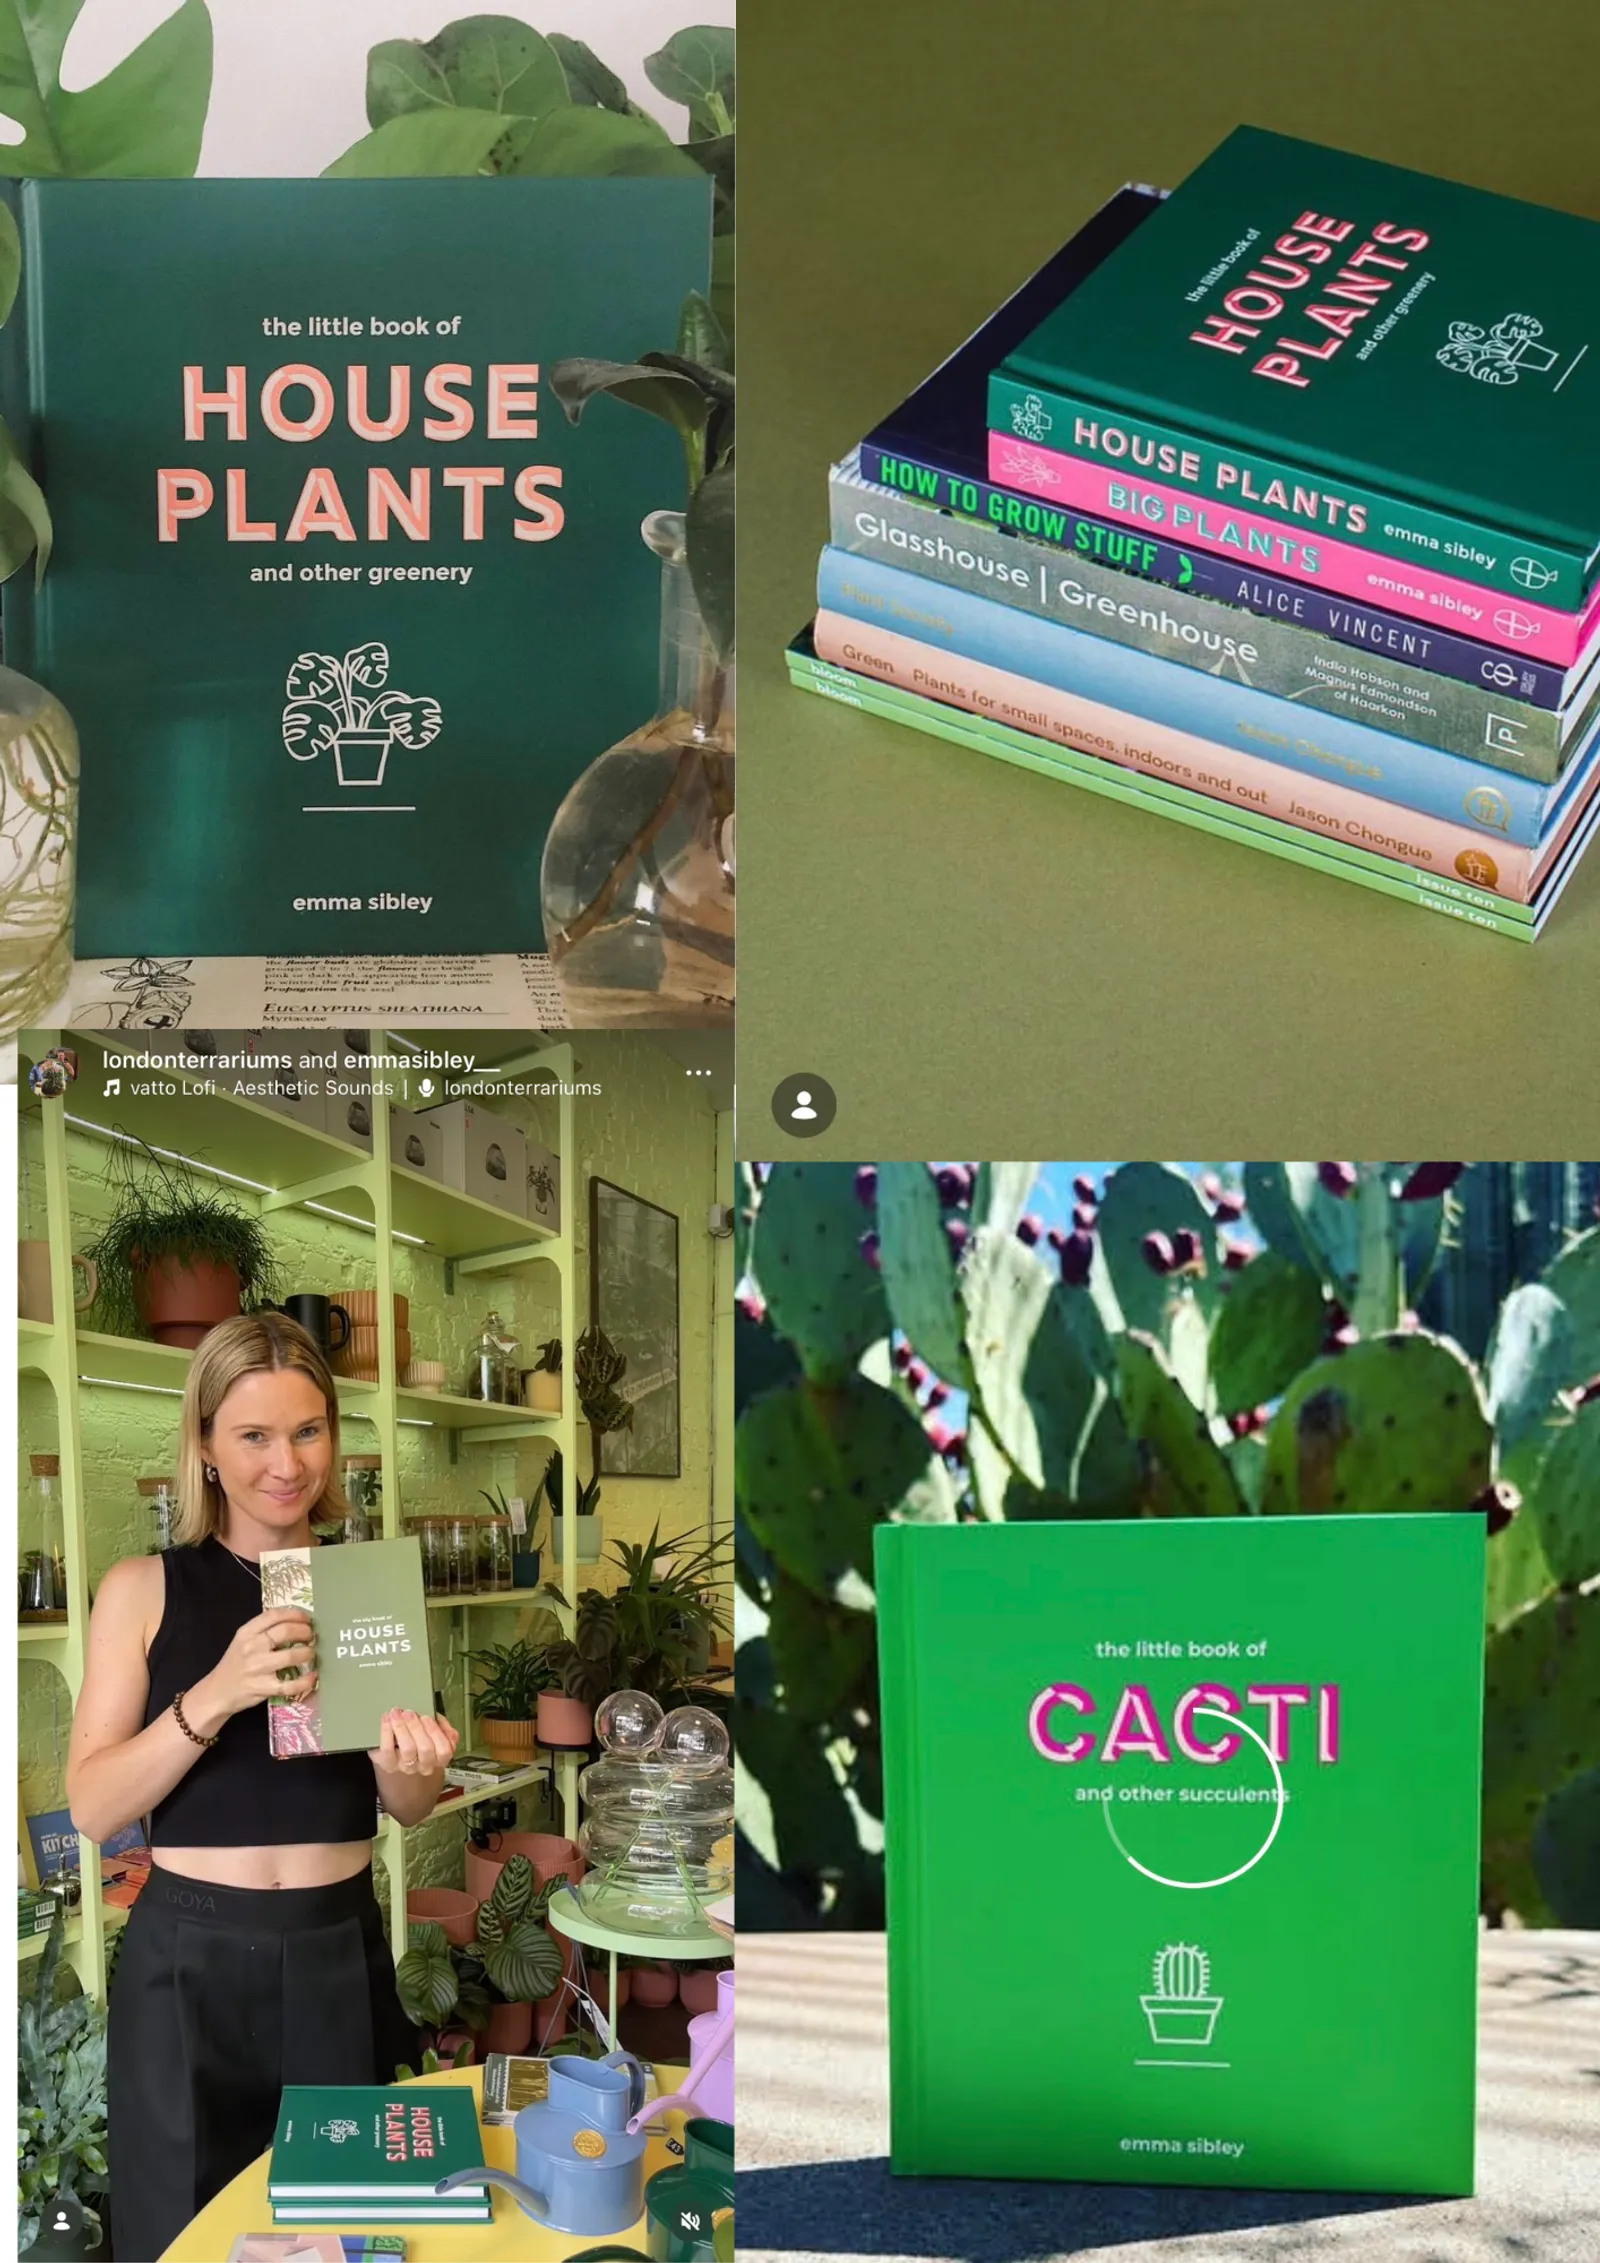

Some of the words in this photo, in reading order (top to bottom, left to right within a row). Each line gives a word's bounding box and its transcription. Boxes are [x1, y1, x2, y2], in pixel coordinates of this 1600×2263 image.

[1184, 286, 1208, 302] the
[1200, 263, 1229, 286] little
[1221, 240, 1253, 263] book
[1246, 227, 1261, 240] of
[1189, 210, 1355, 355] HOUSE
[262, 317, 301, 336] the
[308, 317, 363, 336] little
[370, 317, 429, 336] book
[436, 316, 461, 336] of
[1251, 221, 1430, 388] PLANTS
[1356, 339, 1378, 361] and
[1373, 313, 1399, 340] other
[1394, 271, 1436, 315] greenery
[183, 363, 540, 442] HOUSE
[157, 465, 565, 542] PLANTS
[1074, 417, 1200, 481] HOUSE
[1216, 462, 1368, 533] PLANTS
[1384, 523, 1439, 551] emma
[1444, 540, 1496, 569] sibley
[250, 564, 292, 582] and
[299, 564, 362, 582] other
[368, 566, 473, 585] greenery
[880, 457, 938, 499] HOW
[947, 477, 978, 512] TO
[987, 493, 1067, 540] GROW
[1075, 521, 1158, 572] STUFF
[1237, 581, 1304, 618] ALICE
[1329, 608, 1432, 658] VINCENT
[1108, 481, 1165, 522] BIG
[1173, 504, 1321, 573] PLANTS
[1367, 572, 1425, 601] emma
[1430, 590, 1483, 621] sibley
[855, 512, 1030, 589] Glasshouse
[1059, 580, 1259, 663] Greenhouse
[1304, 667, 1356, 690] Magnus
[1360, 683, 1437, 717] Edmondson
[1314, 655, 1347, 674] India
[1351, 667, 1400, 691] Hobson
[1403, 685, 1430, 701] and
[1334, 690, 1347, 701] of
[1350, 695, 1405, 720] Haarkon
[811, 661, 857, 687] bloom
[1466, 892, 1495, 909] ten
[843, 644, 895, 673] Green
[913, 668, 967, 700] Plants
[971, 689, 997, 711] for
[1001, 702, 1048, 728] small
[1054, 720, 1119, 753] spaces,
[1123, 743, 1192, 778] indoors
[1197, 770, 1232, 792] and
[1236, 786, 1269, 804] out
[1288, 801, 1341, 829] Jason
[1345, 820, 1433, 862] Chongue
[815, 680, 862, 707] bloom
[1467, 910, 1497, 929] ten
[293, 896, 362, 911] emma
[368, 893, 433, 914] sibley
[336, 1639, 411, 1659] PLANTS
[339, 1623, 406, 1642] HOUSE
[1096, 1641, 1130, 1658] the
[1136, 1640, 1182, 1658] little
[1188, 1640, 1240, 1658] book
[1245, 1640, 1268, 1658] of
[1028, 1681, 1340, 1763] CACTI
[1075, 1785, 1113, 1802] and
[1118, 1785, 1173, 1802] other
[166, 1887, 216, 1913] GOYA
[385, 2103, 408, 2162] PLANTS
[410, 2107, 434, 2157] HOUSE
[1119, 2137, 1182, 2153] emma
[1187, 2138, 1245, 2158] sibley
